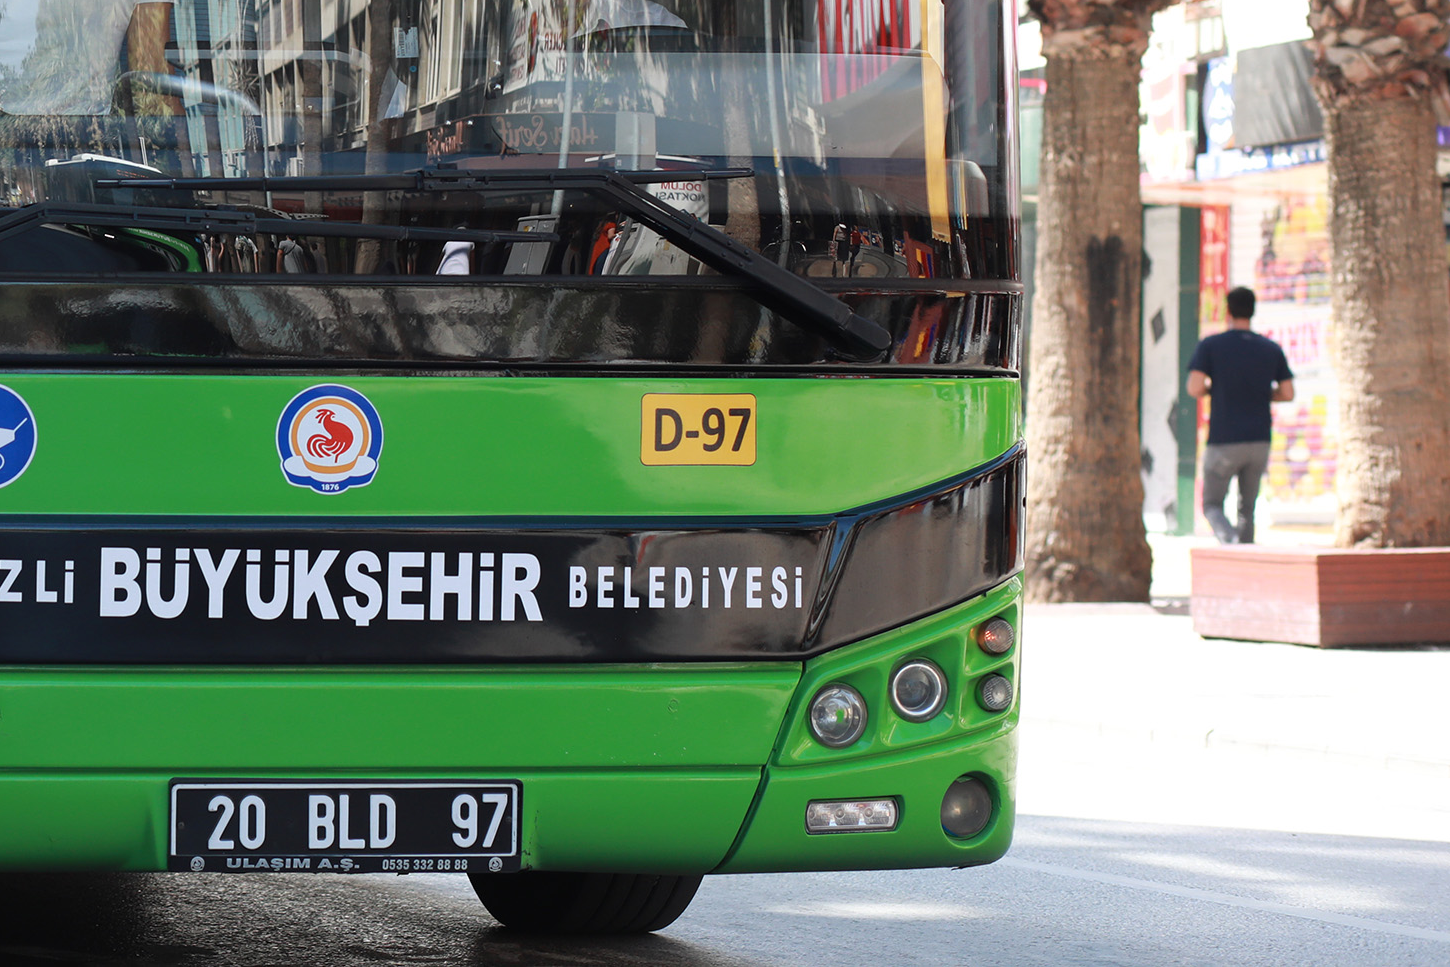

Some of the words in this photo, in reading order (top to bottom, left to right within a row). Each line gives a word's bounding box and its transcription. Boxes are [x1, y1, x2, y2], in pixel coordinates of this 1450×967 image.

[654, 407, 751, 452] D-97
[321, 483, 340, 491] 1876
[207, 794, 266, 850] 20
[308, 794, 397, 850] BLD
[451, 793, 509, 849] 97
[226, 857, 312, 873] ULAŞIM
[317, 857, 361, 872] A.Ş.
[382, 859, 410, 871] 0535
[413, 859, 434, 871] 332
[437, 859, 451, 871] 88
[454, 859, 468, 871] 88
